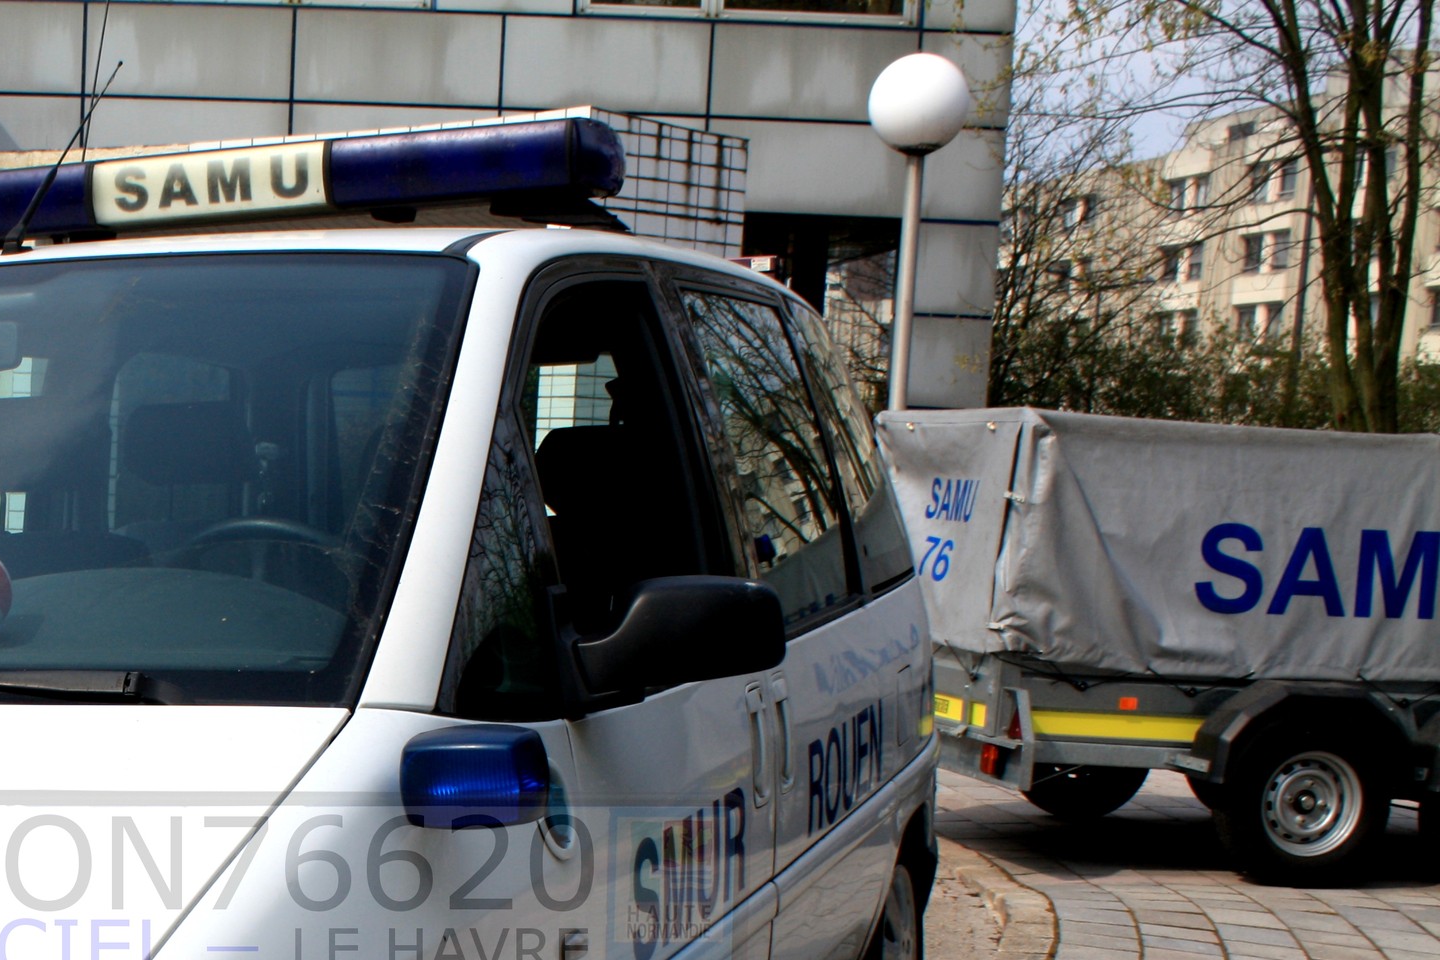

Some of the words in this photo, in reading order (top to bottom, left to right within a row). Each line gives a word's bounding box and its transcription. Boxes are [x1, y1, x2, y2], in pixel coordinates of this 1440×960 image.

[113, 152, 309, 213] SAMU
[925, 477, 980, 522] SAMU
[919, 536, 954, 582] 76
[1195, 523, 1440, 620] SAM
[808, 699, 883, 837] ROUEN
